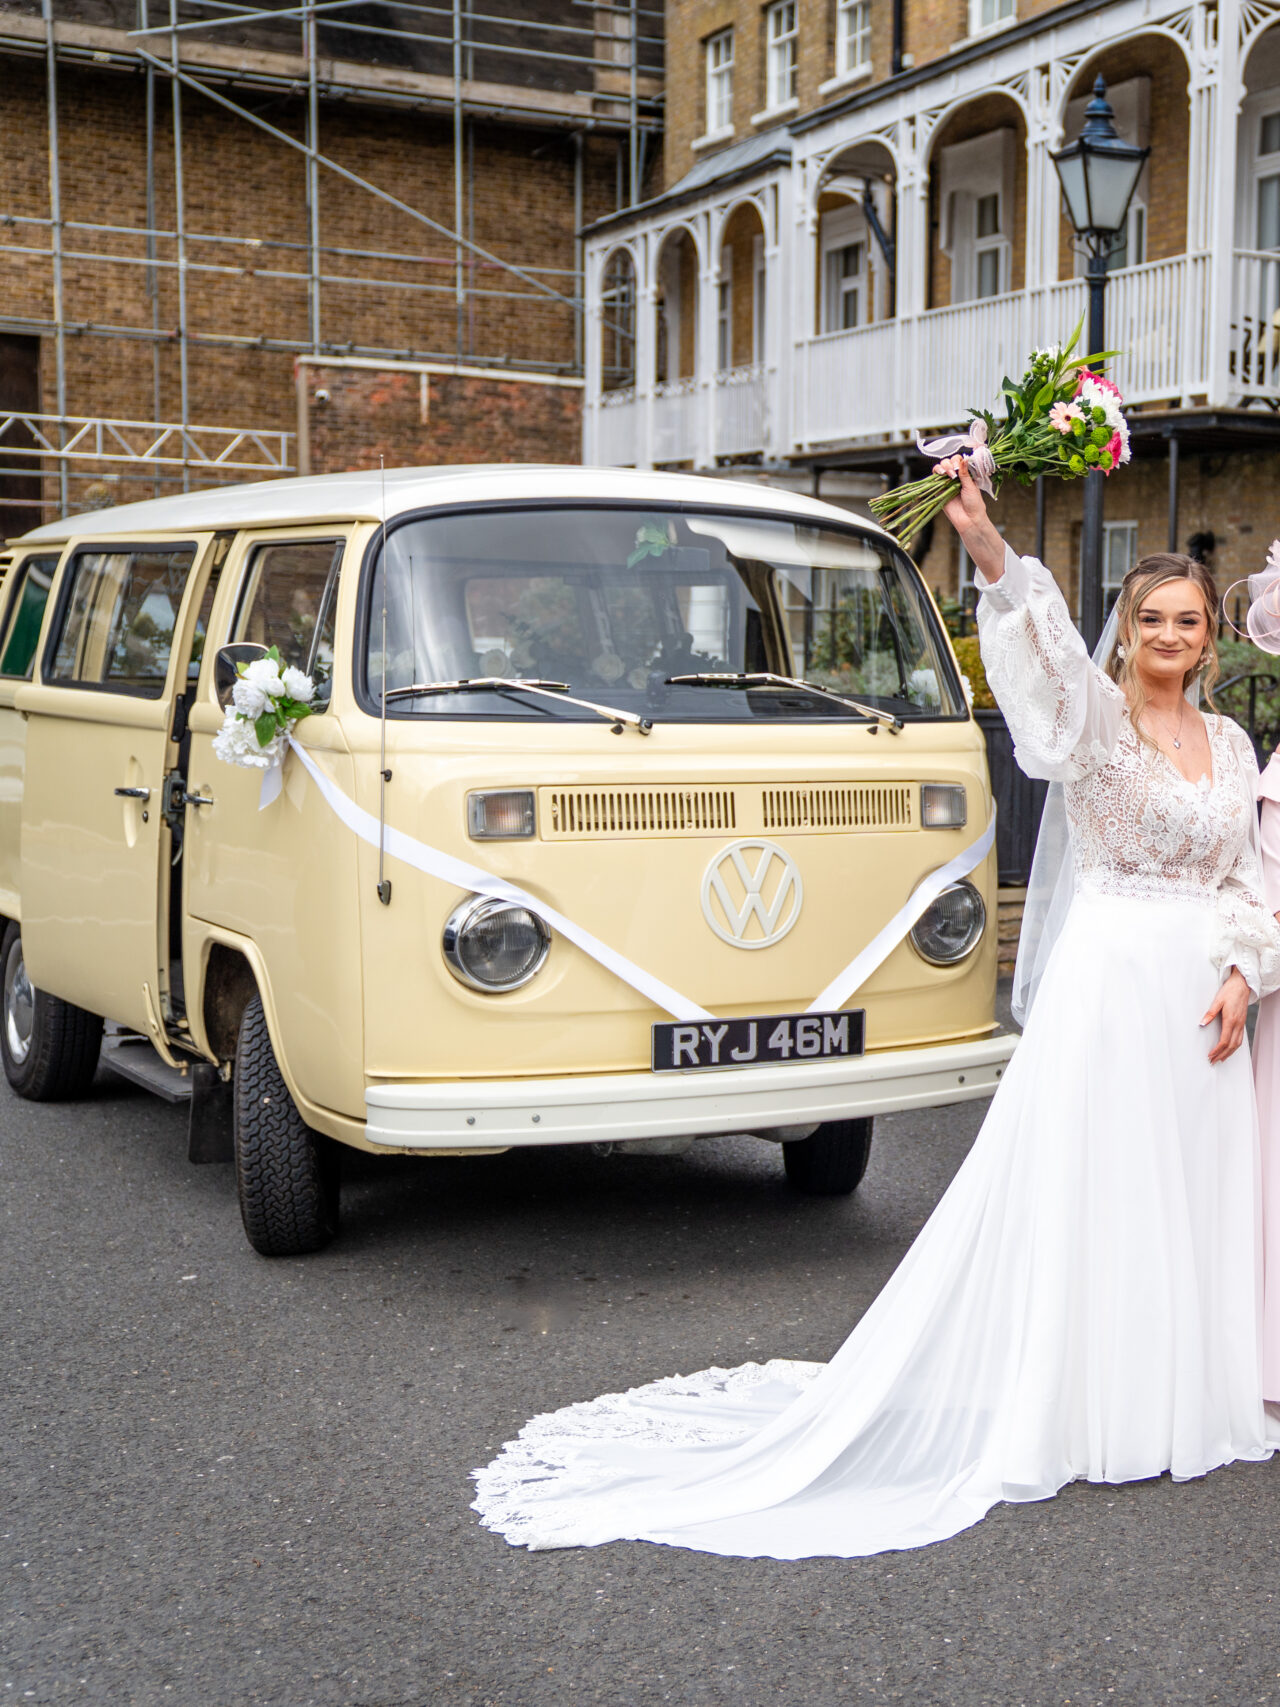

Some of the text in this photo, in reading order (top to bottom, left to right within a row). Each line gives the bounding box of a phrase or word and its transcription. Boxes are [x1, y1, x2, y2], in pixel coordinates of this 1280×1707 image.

[706, 843, 798, 943] VW
[672, 1015, 849, 1066] RYJ 46M
